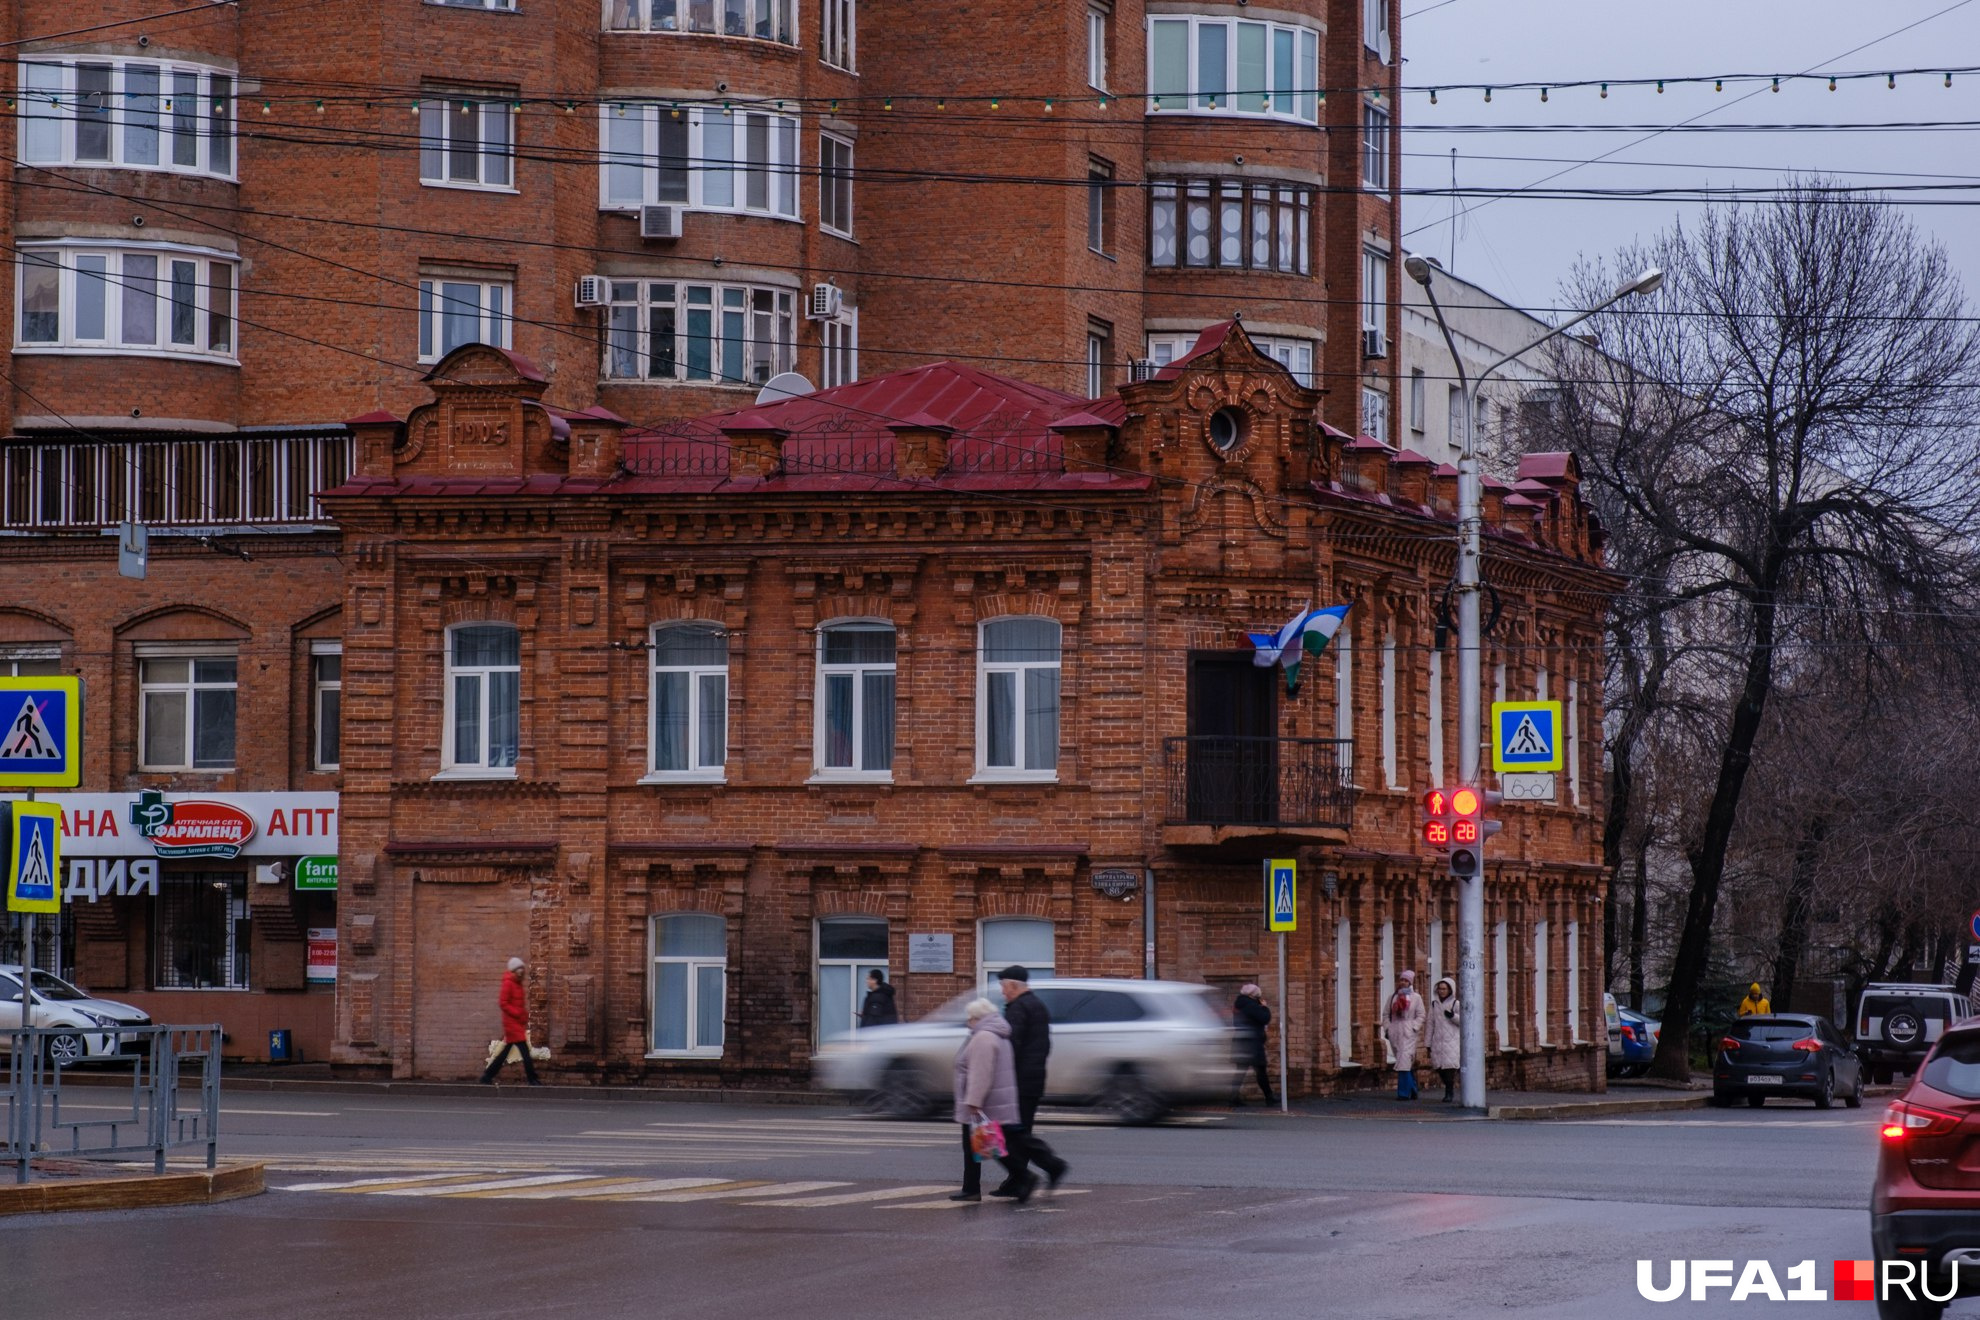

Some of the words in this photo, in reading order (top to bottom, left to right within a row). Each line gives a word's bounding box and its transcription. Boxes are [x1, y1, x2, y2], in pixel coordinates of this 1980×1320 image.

[455, 421, 508, 446] 1905
[267, 808, 339, 836] АПТ
[154, 825, 243, 840] ФАРМЛЕНД
[1429, 825, 1447, 842] 26
[1456, 823, 1476, 840] 28
[60, 859, 159, 903] ДИЯ
[1109, 887, 1120, 895] 86
